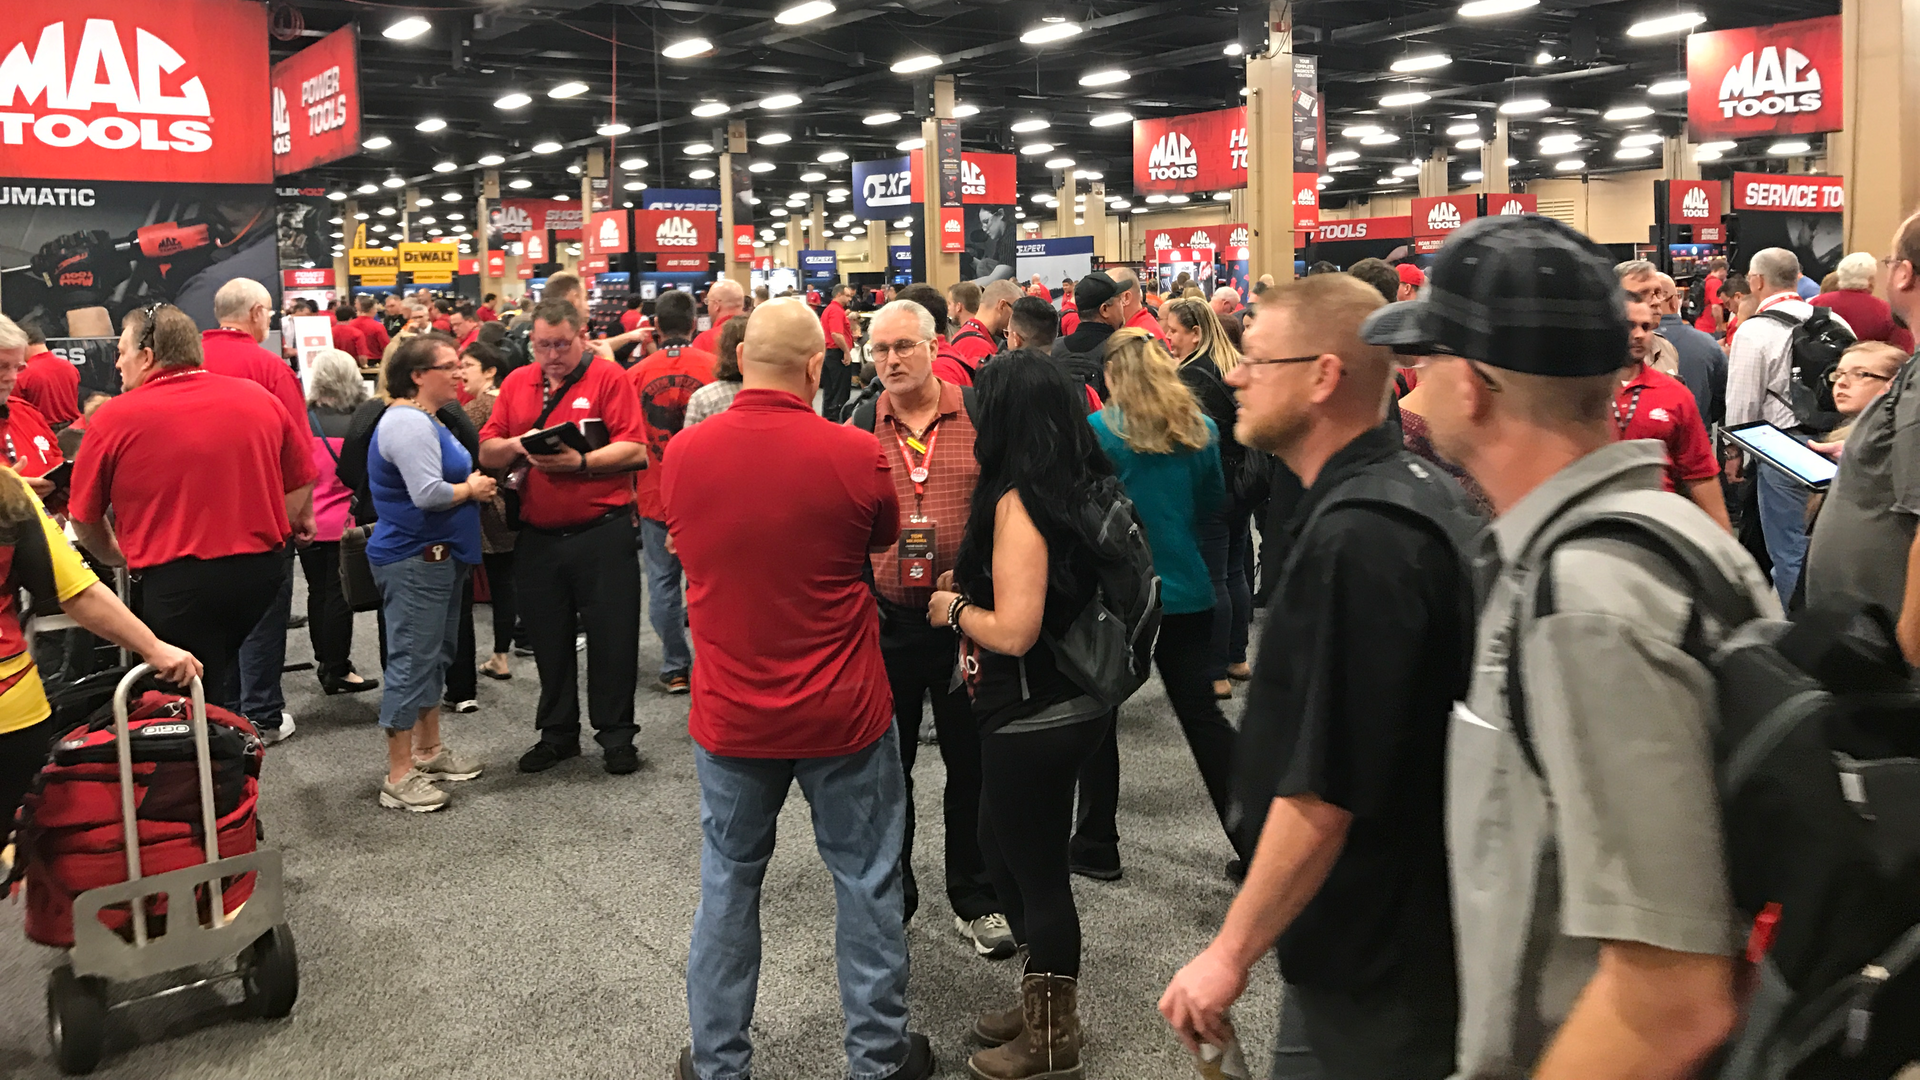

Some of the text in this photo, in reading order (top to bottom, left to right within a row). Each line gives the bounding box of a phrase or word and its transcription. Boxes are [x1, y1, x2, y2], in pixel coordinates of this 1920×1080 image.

[0, 18, 211, 117] MAC
[1719, 46, 1822, 101] MAC
[302, 66, 340, 107] POWER
[308, 94, 346, 136] TOOLS
[1718, 93, 1822, 118] TOOLS
[0, 112, 213, 153] TOOLS
[1149, 131, 1197, 168] MAC
[1148, 165, 1198, 181] TOOLS
[1682, 187, 1709, 209] MAC
[1745, 183, 1844, 207] SERVICE TO
[1428, 202, 1461, 222] MAC
[1683, 209, 1709, 217] TOOLS
[656, 217, 697, 237] MAC
[1319, 223, 1367, 240] TOOLS
[1428, 220, 1461, 230] TOOLS
[656, 238, 698, 246] TOOLS
